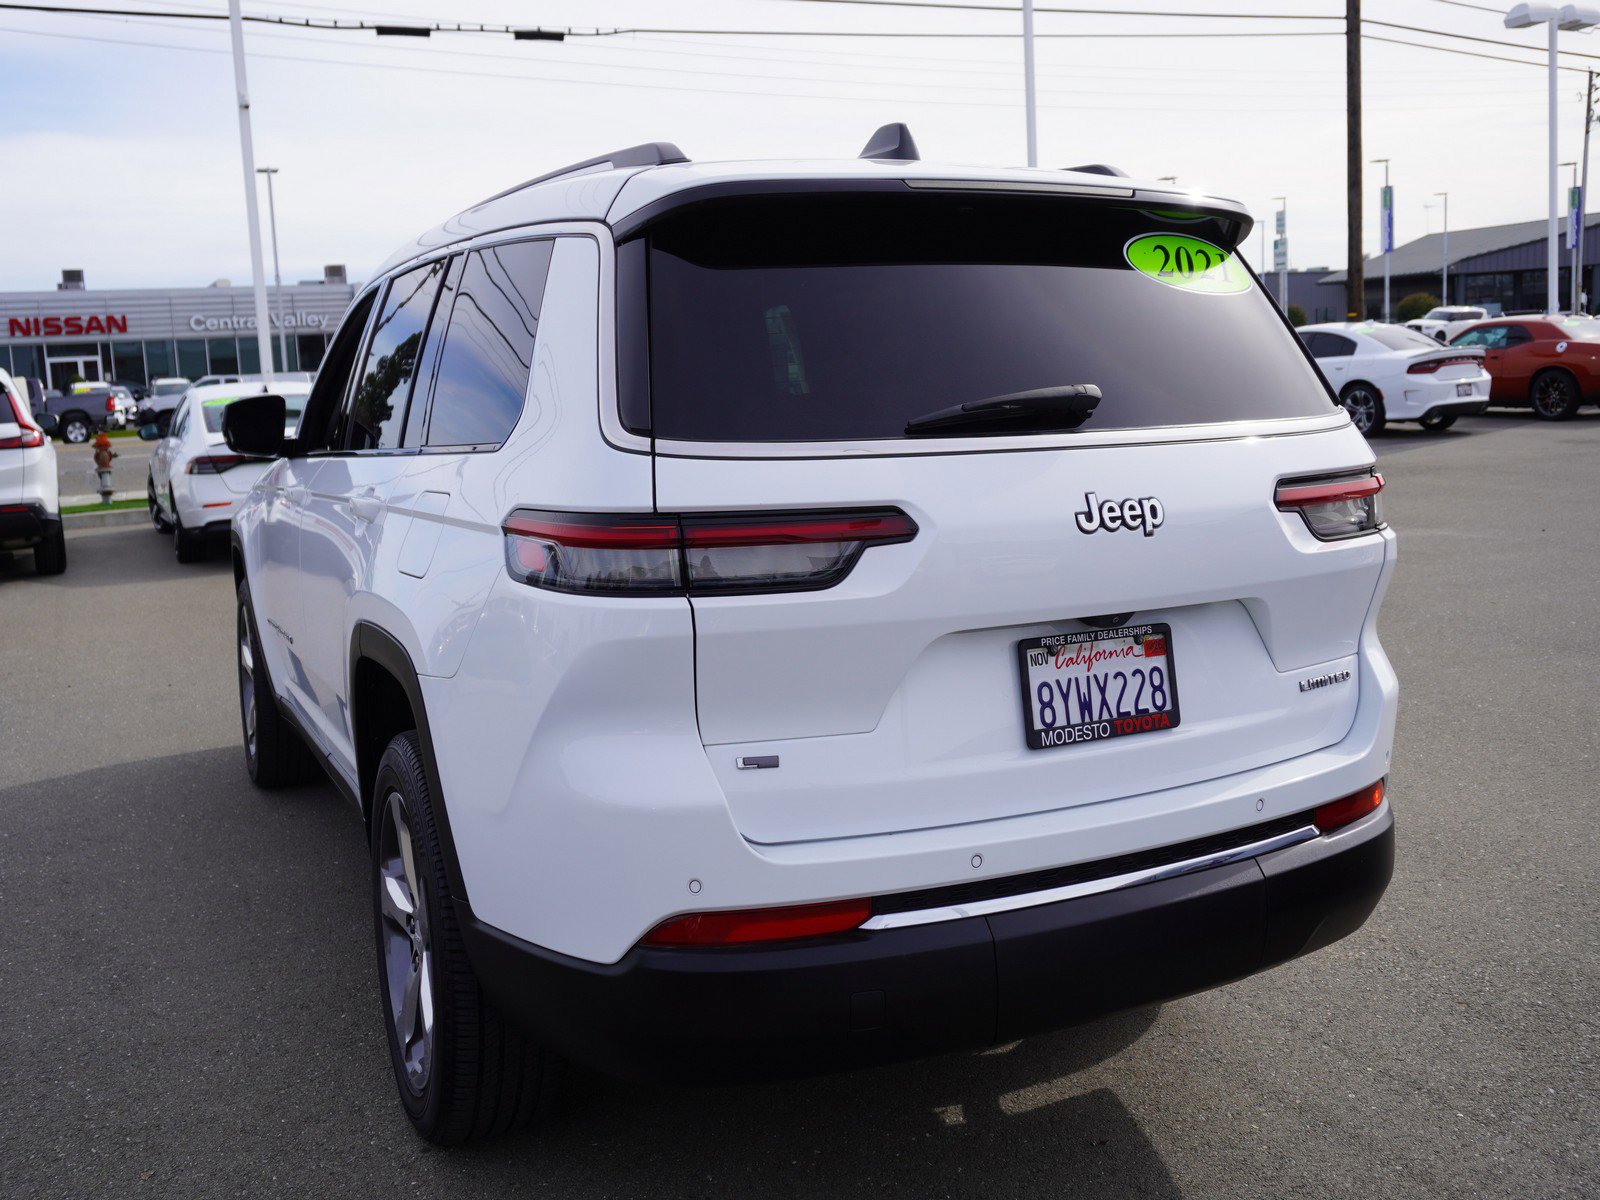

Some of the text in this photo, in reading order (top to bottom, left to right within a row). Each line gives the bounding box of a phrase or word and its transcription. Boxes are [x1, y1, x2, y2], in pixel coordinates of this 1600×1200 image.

[1152, 244, 1232, 283] 2021
[8, 314, 128, 337] NISSAN
[189, 312, 258, 331] Centra
[1074, 491, 1165, 537] Jeep
[1041, 625, 1153, 647] PRICE FAMILY DEALERSHIPS
[1029, 651, 1049, 667] NOV
[1055, 641, 1144, 672] California
[1037, 665, 1167, 729] 8YWX228
[1041, 713, 1170, 747] MODESTO TOYOTA
